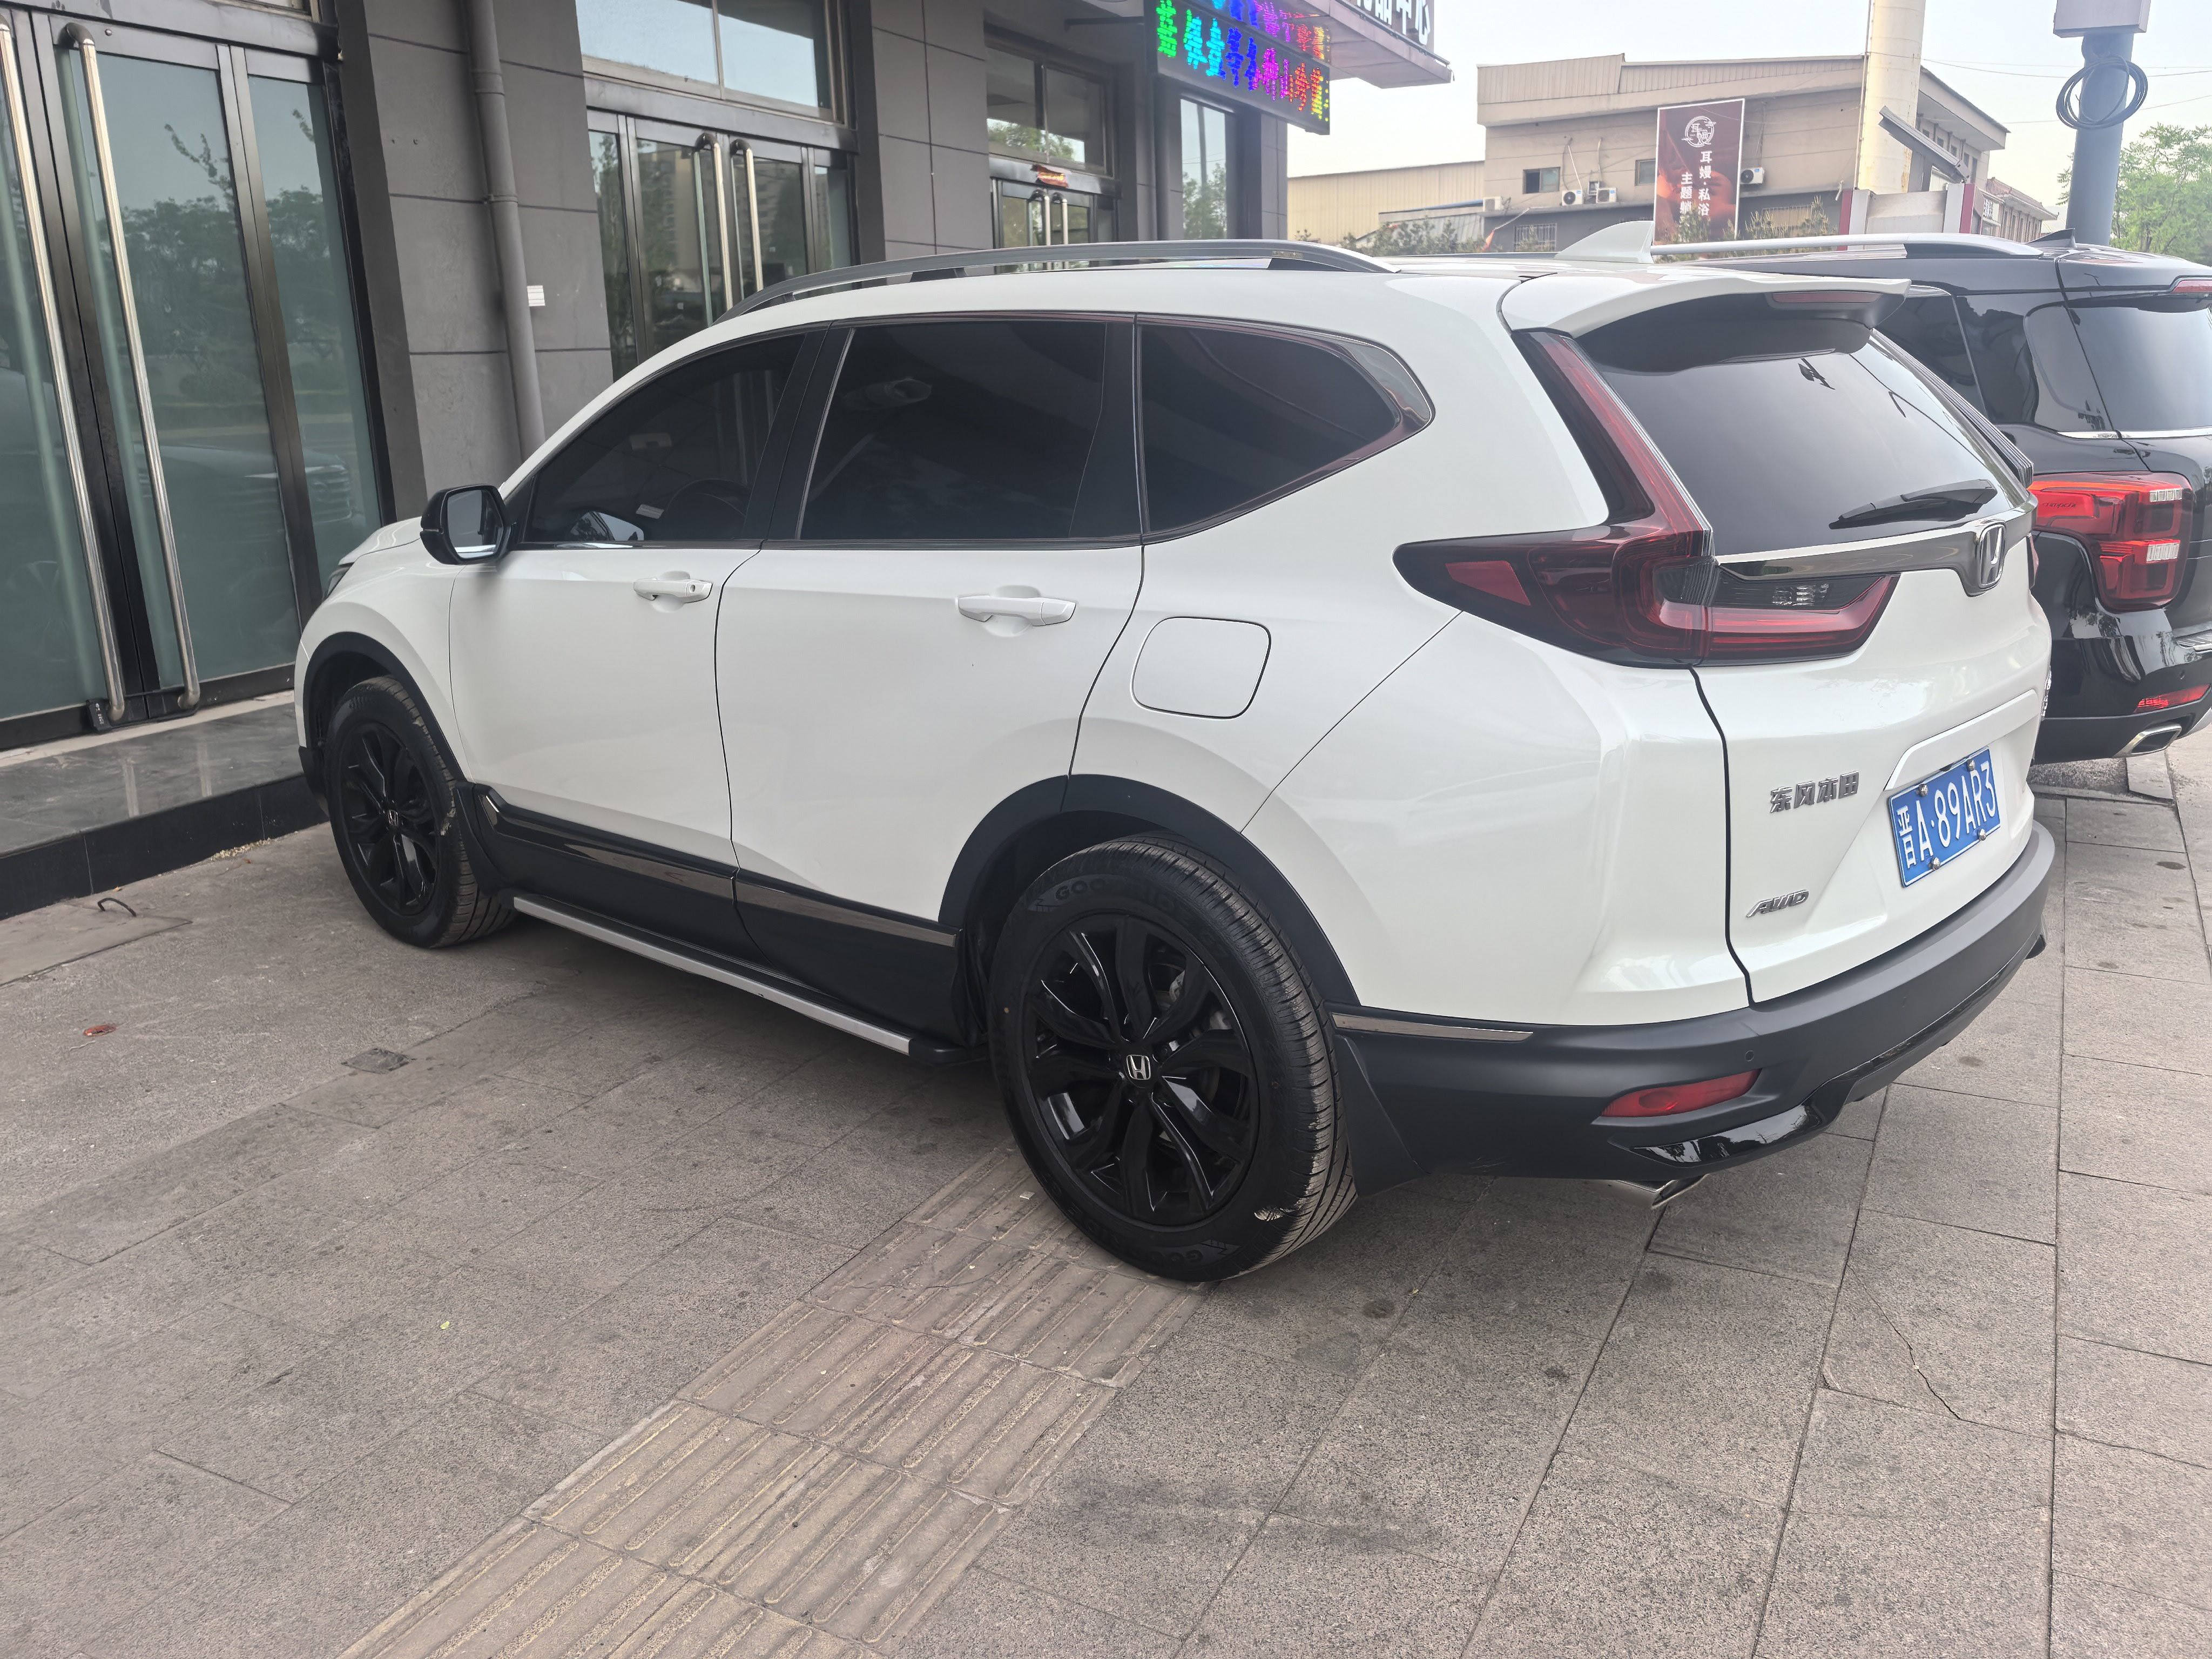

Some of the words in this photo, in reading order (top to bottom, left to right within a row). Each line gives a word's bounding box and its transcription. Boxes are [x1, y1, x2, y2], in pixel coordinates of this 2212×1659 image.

[1770, 771, 1859, 813] 东风本田
[1746, 889, 1809, 918] AWD
